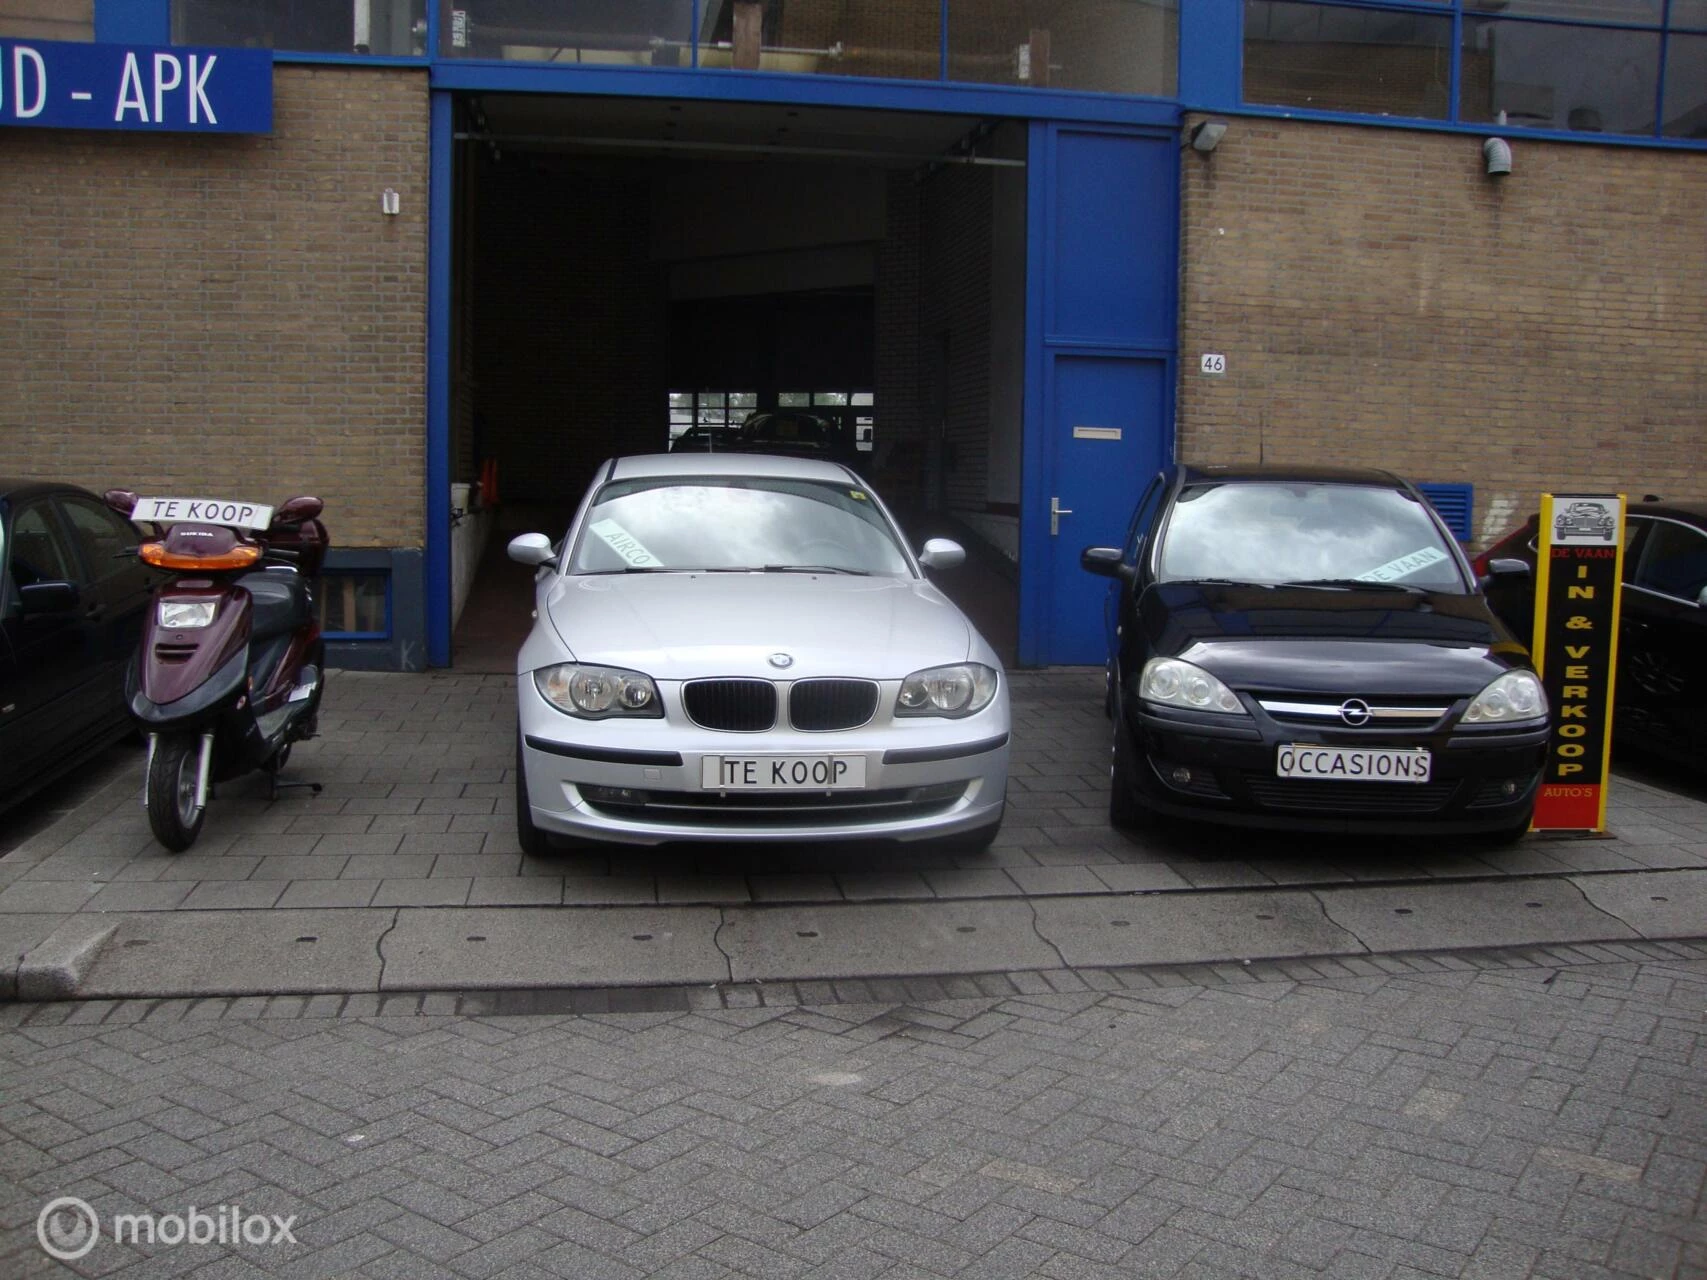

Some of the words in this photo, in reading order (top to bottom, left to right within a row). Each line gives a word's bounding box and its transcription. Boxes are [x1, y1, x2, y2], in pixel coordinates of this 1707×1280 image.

[0, 46, 47, 118] D
[115, 52, 218, 124] APK
[1204, 356, 1223, 371] 46
[153, 501, 179, 518] TE
[187, 502, 253, 523] KOOP
[604, 532, 650, 564] AIRCO
[1551, 548, 1571, 558] DE
[1574, 548, 1614, 558] VAAN
[1388, 551, 1438, 573] VAAN
[1568, 565, 1594, 599] IN
[1565, 615, 1593, 630] &
[1557, 646, 1591, 776] VERKOOP
[725, 761, 757, 784] TE
[772, 761, 847, 785] KOOP
[1280, 751, 1428, 777] OCCASIONS
